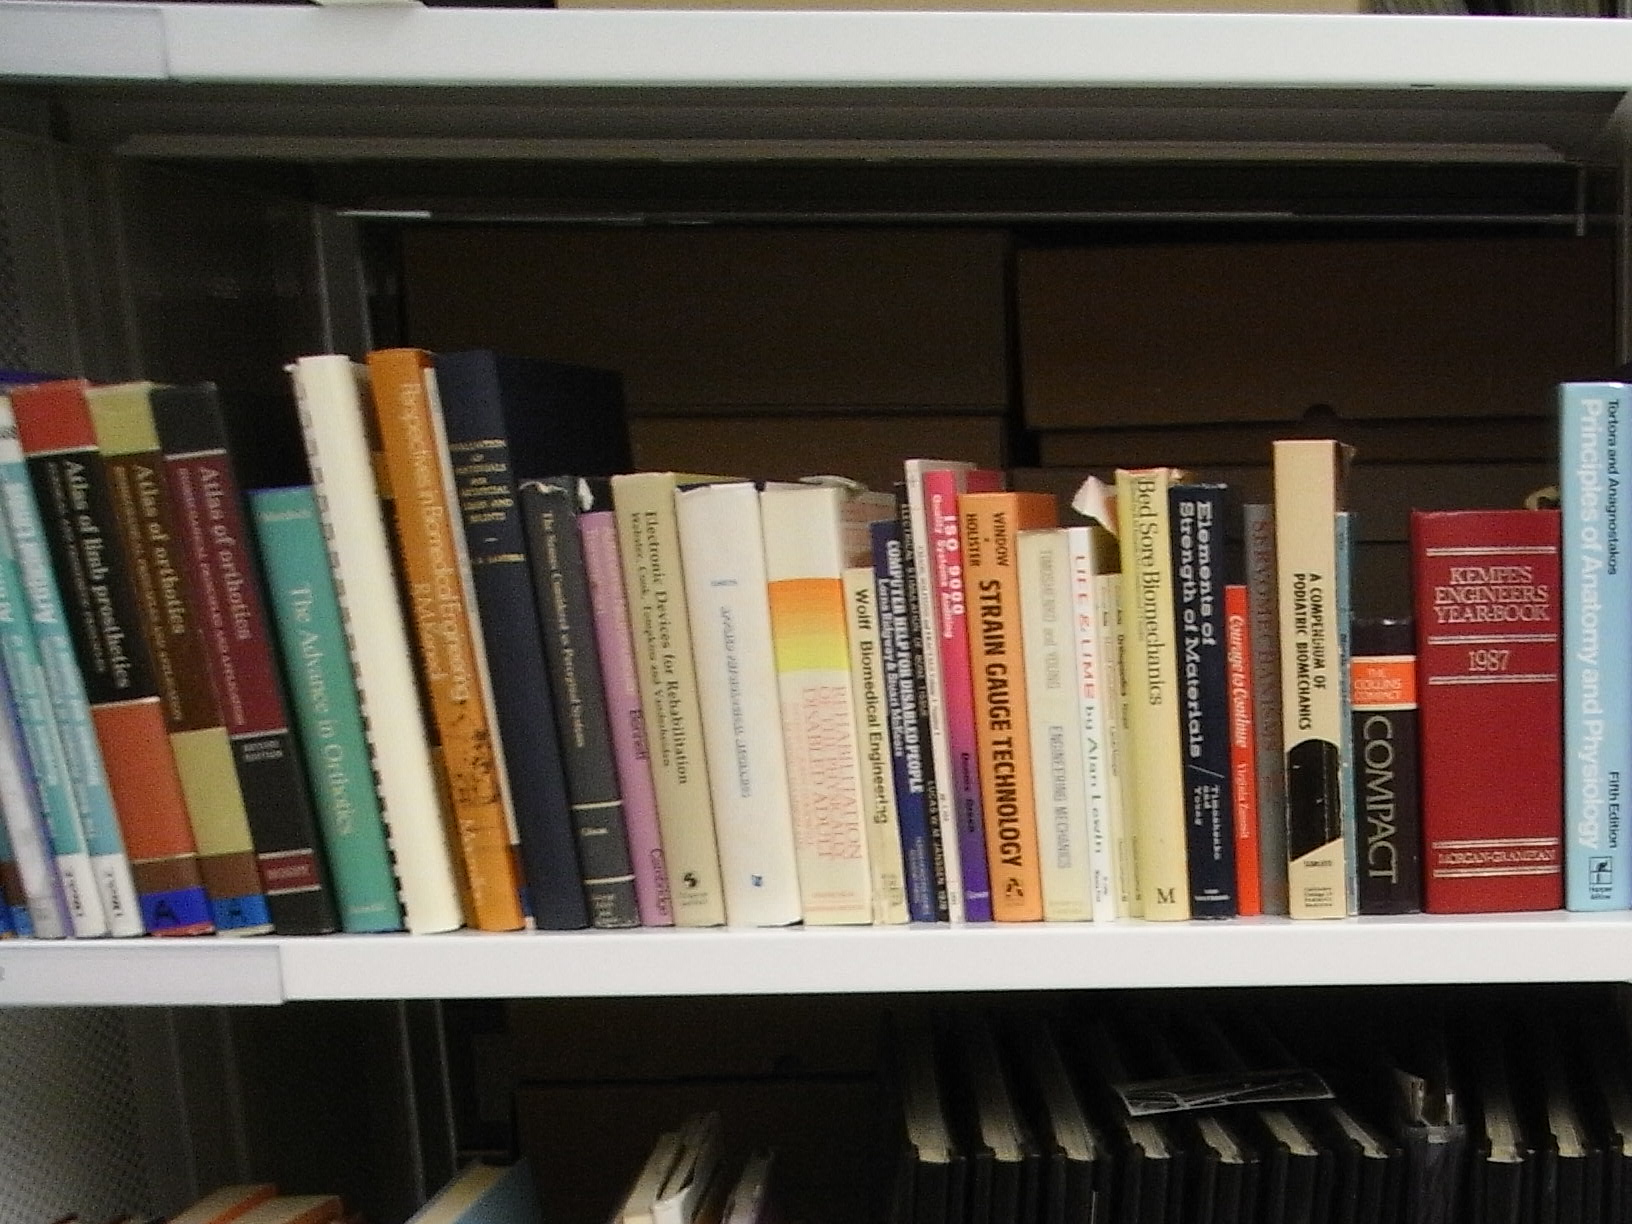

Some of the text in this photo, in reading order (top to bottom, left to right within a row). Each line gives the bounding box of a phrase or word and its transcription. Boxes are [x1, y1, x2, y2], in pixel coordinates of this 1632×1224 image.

[964, 512, 982, 568] HOLISTER
[993, 511, 1010, 567] WINDOW
[1604, 400, 1621, 576] Tortora and Anagnostakos
[943, 514, 965, 615] ISO 9000
[1136, 479, 1167, 706] Bed Sore Biomechanics
[1179, 500, 1204, 759] Strength of Materials
[1195, 500, 1216, 646] Elements of
[1309, 573, 1327, 690] A COMPENDIUM OF
[1577, 400, 1604, 851] Principles of Anatomy and Physiology
[289, 586, 313, 622] The
[319, 720, 338, 739] in
[644, 511, 690, 786] Electronic Devices for Rehabilitation
[855, 589, 891, 825] Wolff Biomedical Engineering
[886, 540, 925, 795] COMPUTER HELP FOR DISABLED PEOPLE
[1227, 615, 1244, 670] Courage
[1231, 672, 1247, 686] to
[1293, 572, 1313, 731] PODIATRIC BIOMECHANICS
[1468, 649, 1512, 672] 1987
[977, 579, 1024, 867] STRAIN GAUGE TECHNOLOGY
[1083, 706, 1105, 854] by Alan Lewin
[1047, 725, 1072, 870] ENGINEERING MECHANICS
[1203, 784, 1213, 810] and
[1211, 784, 1222, 861] Timoshenko
[1361, 713, 1399, 885] COMPACT
[1608, 770, 1620, 849] Fifth Edition
